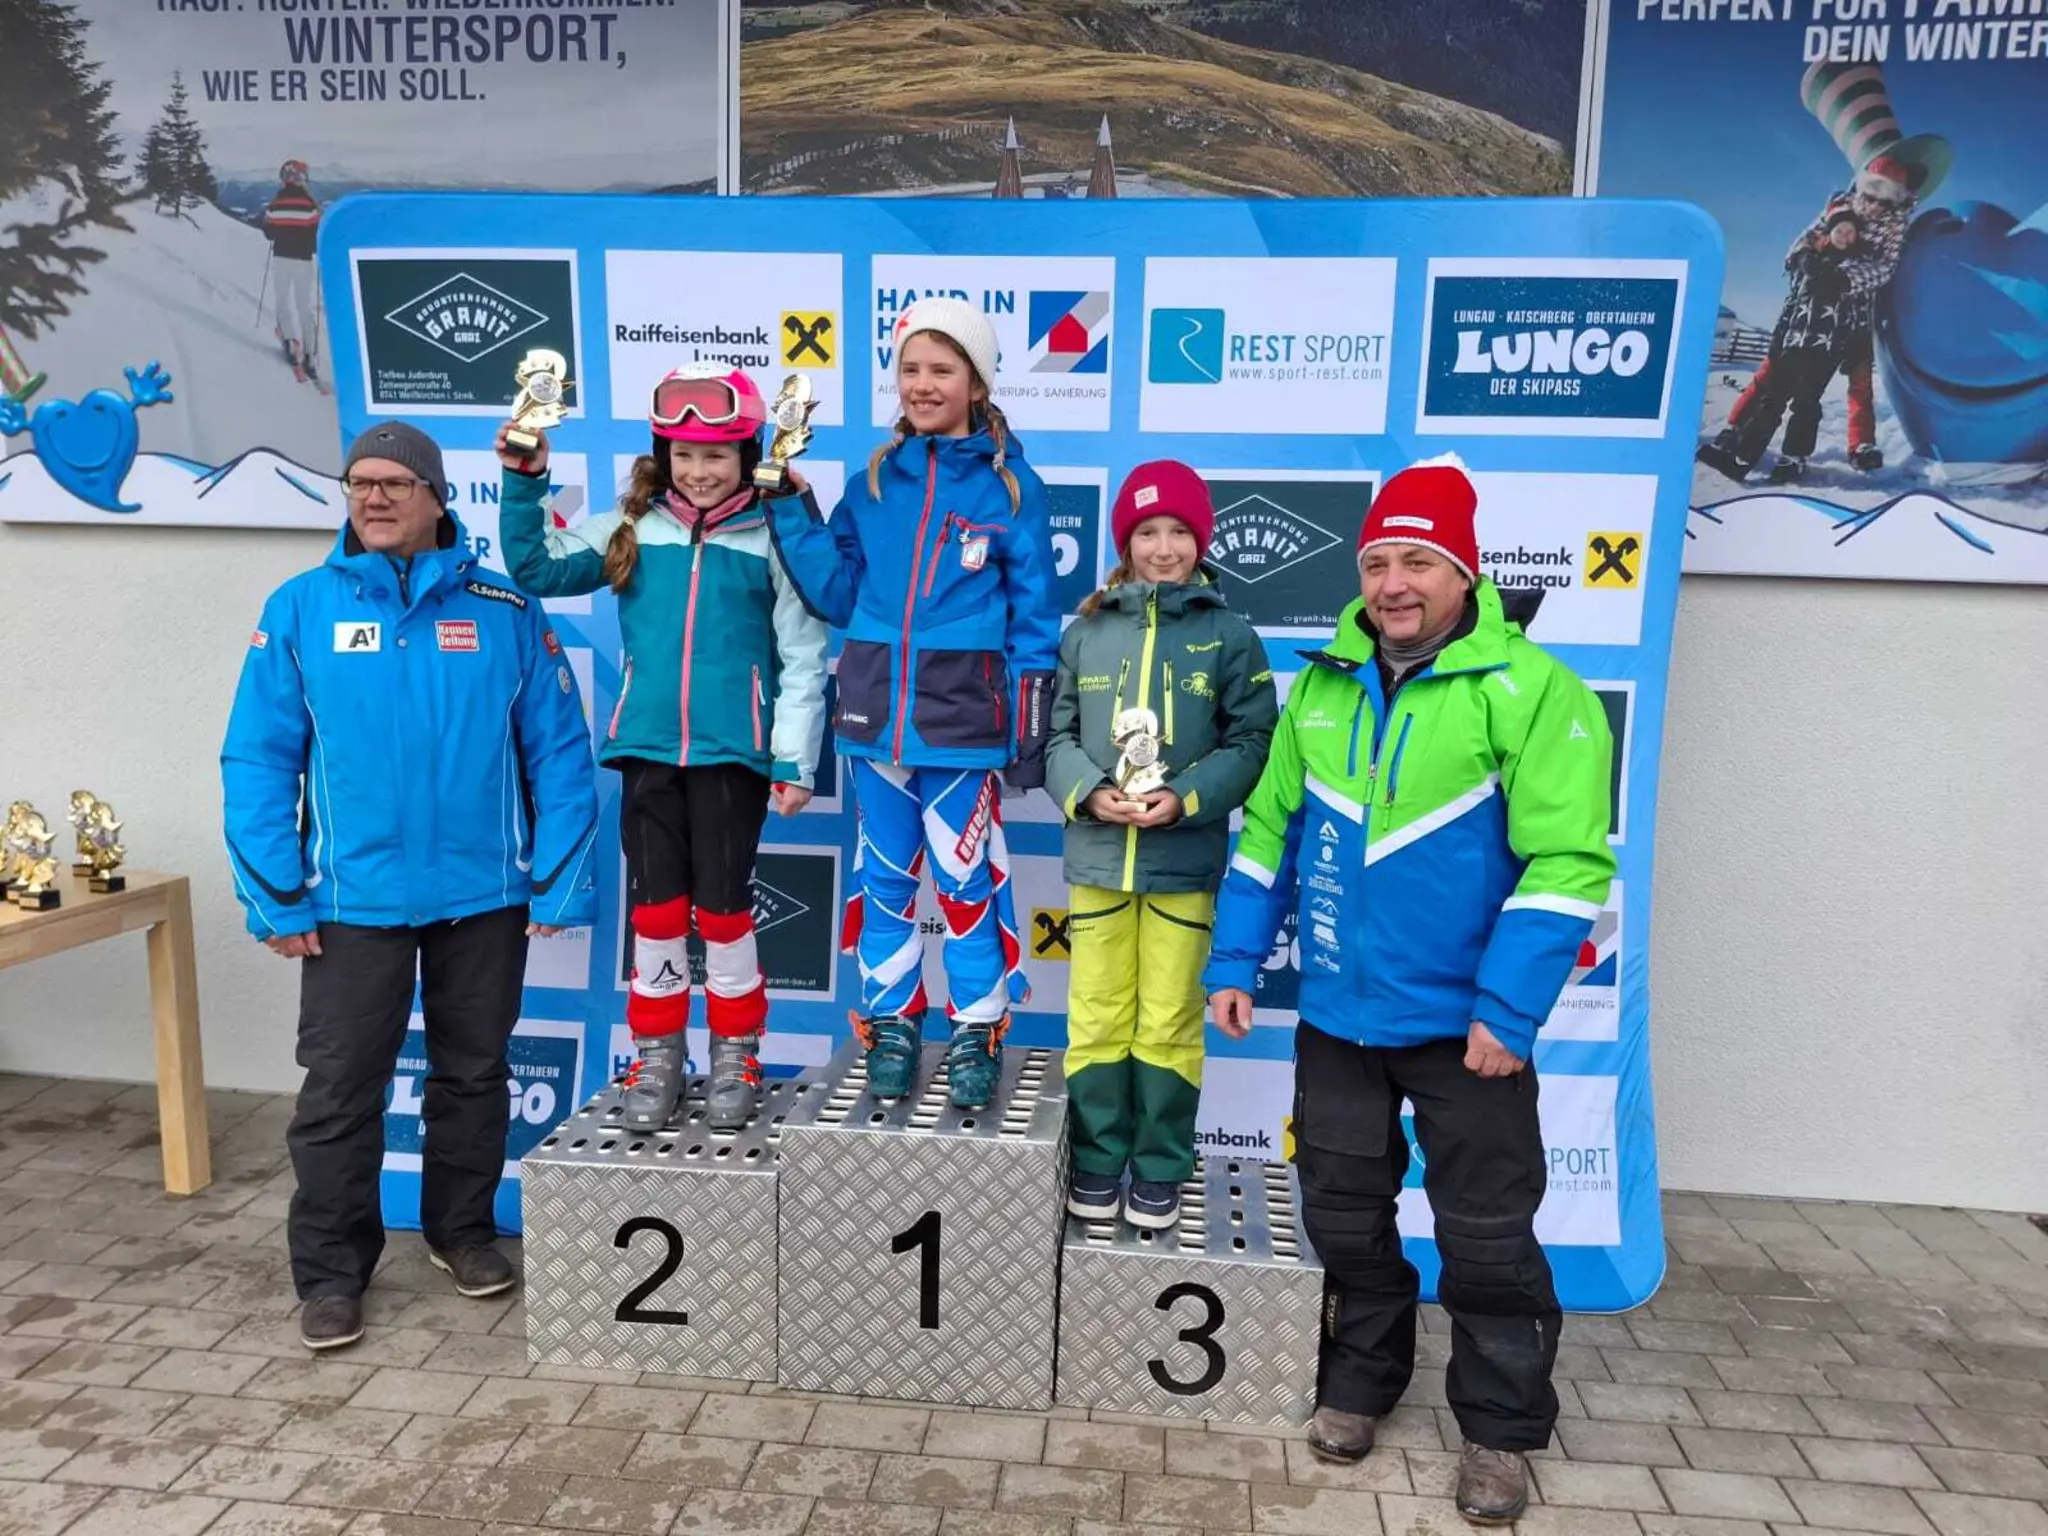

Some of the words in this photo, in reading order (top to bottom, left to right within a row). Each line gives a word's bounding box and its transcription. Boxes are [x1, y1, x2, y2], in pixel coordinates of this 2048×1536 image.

[284, 13, 626, 69] WINTERSPORT,
[1803, 25, 1890, 62] DEIN
[1905, 21, 2048, 61] WINTER
[202, 70, 259, 101] WIE
[270, 70, 307, 101] ER
[320, 69, 386, 101] SEIN
[399, 68, 486, 100] SOLL.
[877, 288, 969, 311] HA
[984, 290, 1014, 313] IN
[425, 306, 510, 339] GRANIT
[1453, 310, 1495, 323] LUNGAU
[1506, 311, 1575, 325] KATSCHBERG
[1586, 312, 1655, 325] OBERTAUERN
[615, 323, 769, 345] Raiffeisenbank
[1230, 335, 1295, 362] REST
[1304, 335, 1385, 363] SPORT
[1453, 328, 1650, 377] LUNGO
[1229, 366, 1382, 381] www.sport-rest.com
[1044, 389, 1106, 399] SANIERUNG
[1490, 379, 1517, 396] DER
[1522, 379, 1582, 397] SKIPASS
[471, 482, 498, 503] IN
[1208, 528, 1298, 560] GRANIT
[1238, 553, 1266, 563] GRAZ
[1494, 570, 1571, 590] Lungau
[396, 1057, 428, 1071] UNGAU
[614, 1216, 688, 1325] 2
[892, 1211, 942, 1329] 1
[1147, 1282, 1226, 1396] 3
